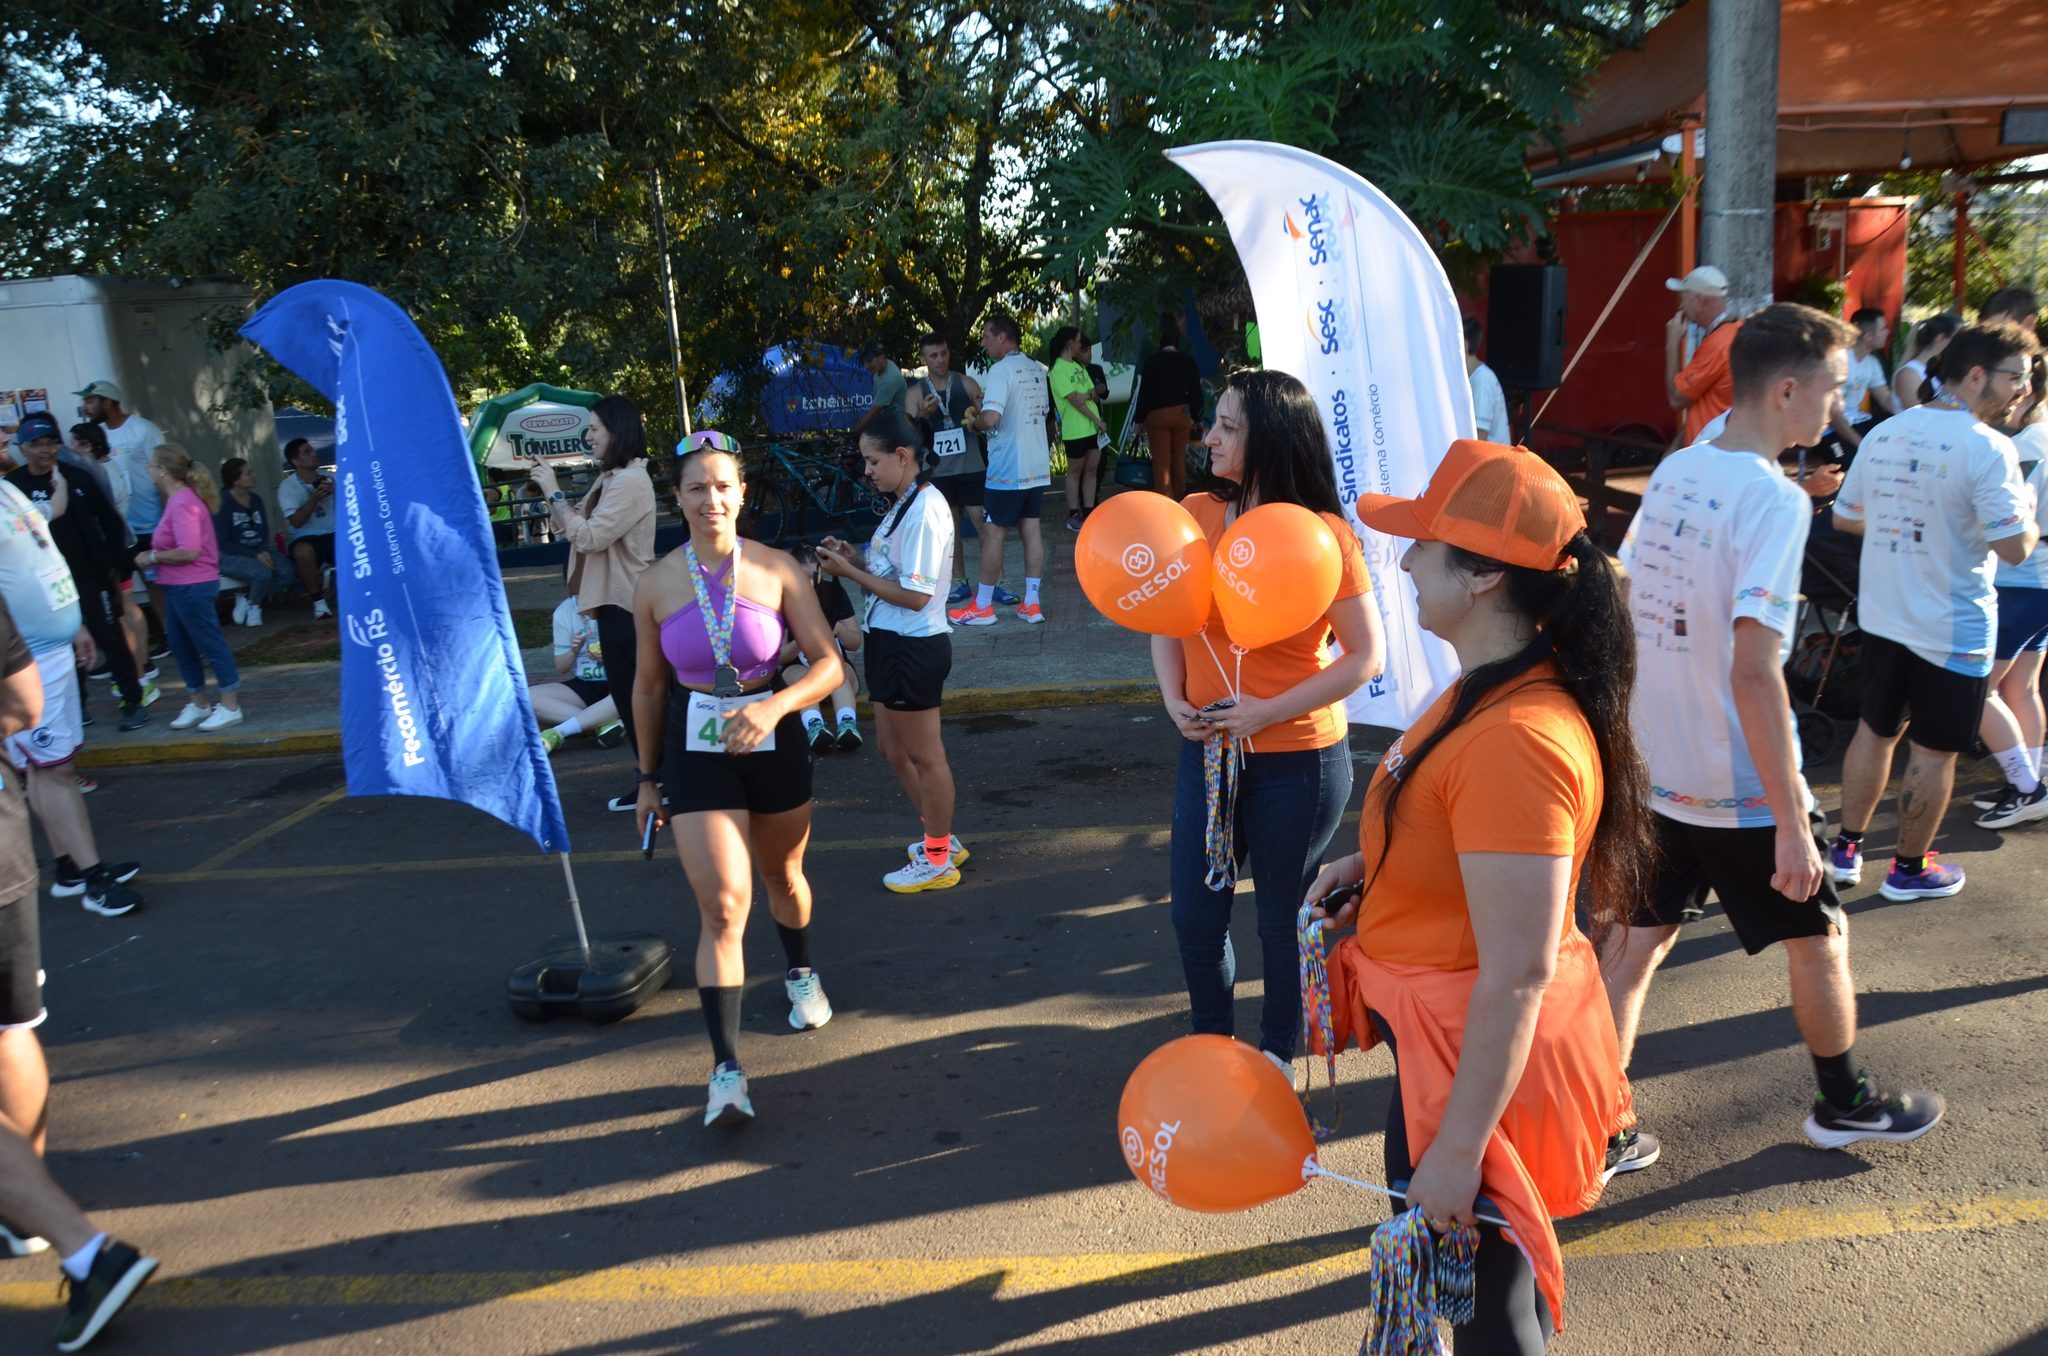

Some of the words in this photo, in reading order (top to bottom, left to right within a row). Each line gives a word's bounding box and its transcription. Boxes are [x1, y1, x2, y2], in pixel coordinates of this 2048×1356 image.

[1299, 193, 1327, 265] Senac
[1317, 299, 1339, 355] Sesc
[526, 417, 575, 428] ERVA-MATE
[1368, 384, 1385, 446] Comércio
[936, 438, 960, 454] 721
[1332, 389, 1358, 504] Sindicatos
[1378, 449, 1391, 496] istema
[370, 461, 391, 518] Comércio
[343, 472, 372, 579] Sindicatos
[384, 521, 405, 574] Sistema
[1116, 558, 1191, 611] CRESOL
[1214, 550, 1258, 606] RESOL
[364, 608, 388, 640] RS
[376, 643, 425, 767] Fecomércio
